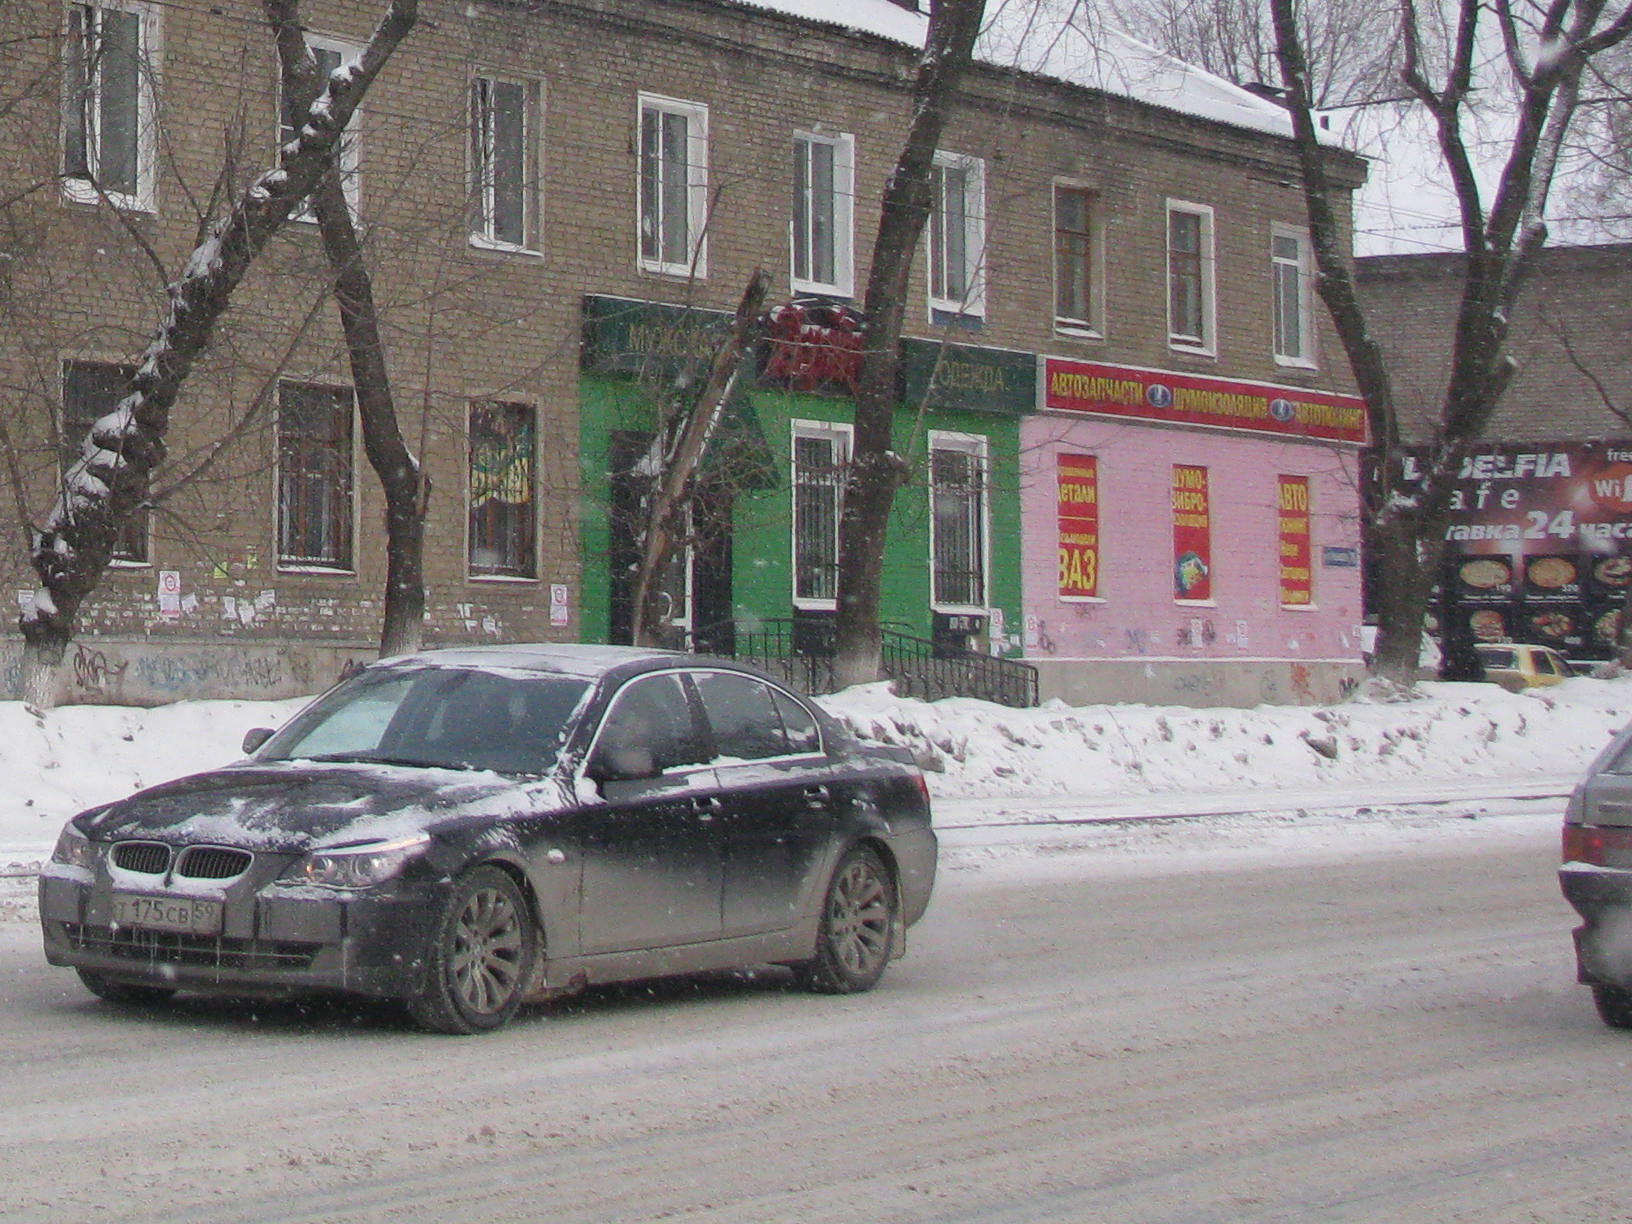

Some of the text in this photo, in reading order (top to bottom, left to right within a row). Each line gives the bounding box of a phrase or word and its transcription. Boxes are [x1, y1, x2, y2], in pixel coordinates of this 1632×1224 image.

[1051, 372, 1143, 406] АВТОЗАПЧАСТИ
[1058, 484, 1095, 503] етали
[1524, 510, 1575, 540] 24
[1058, 549, 1096, 590] ВАЗ
